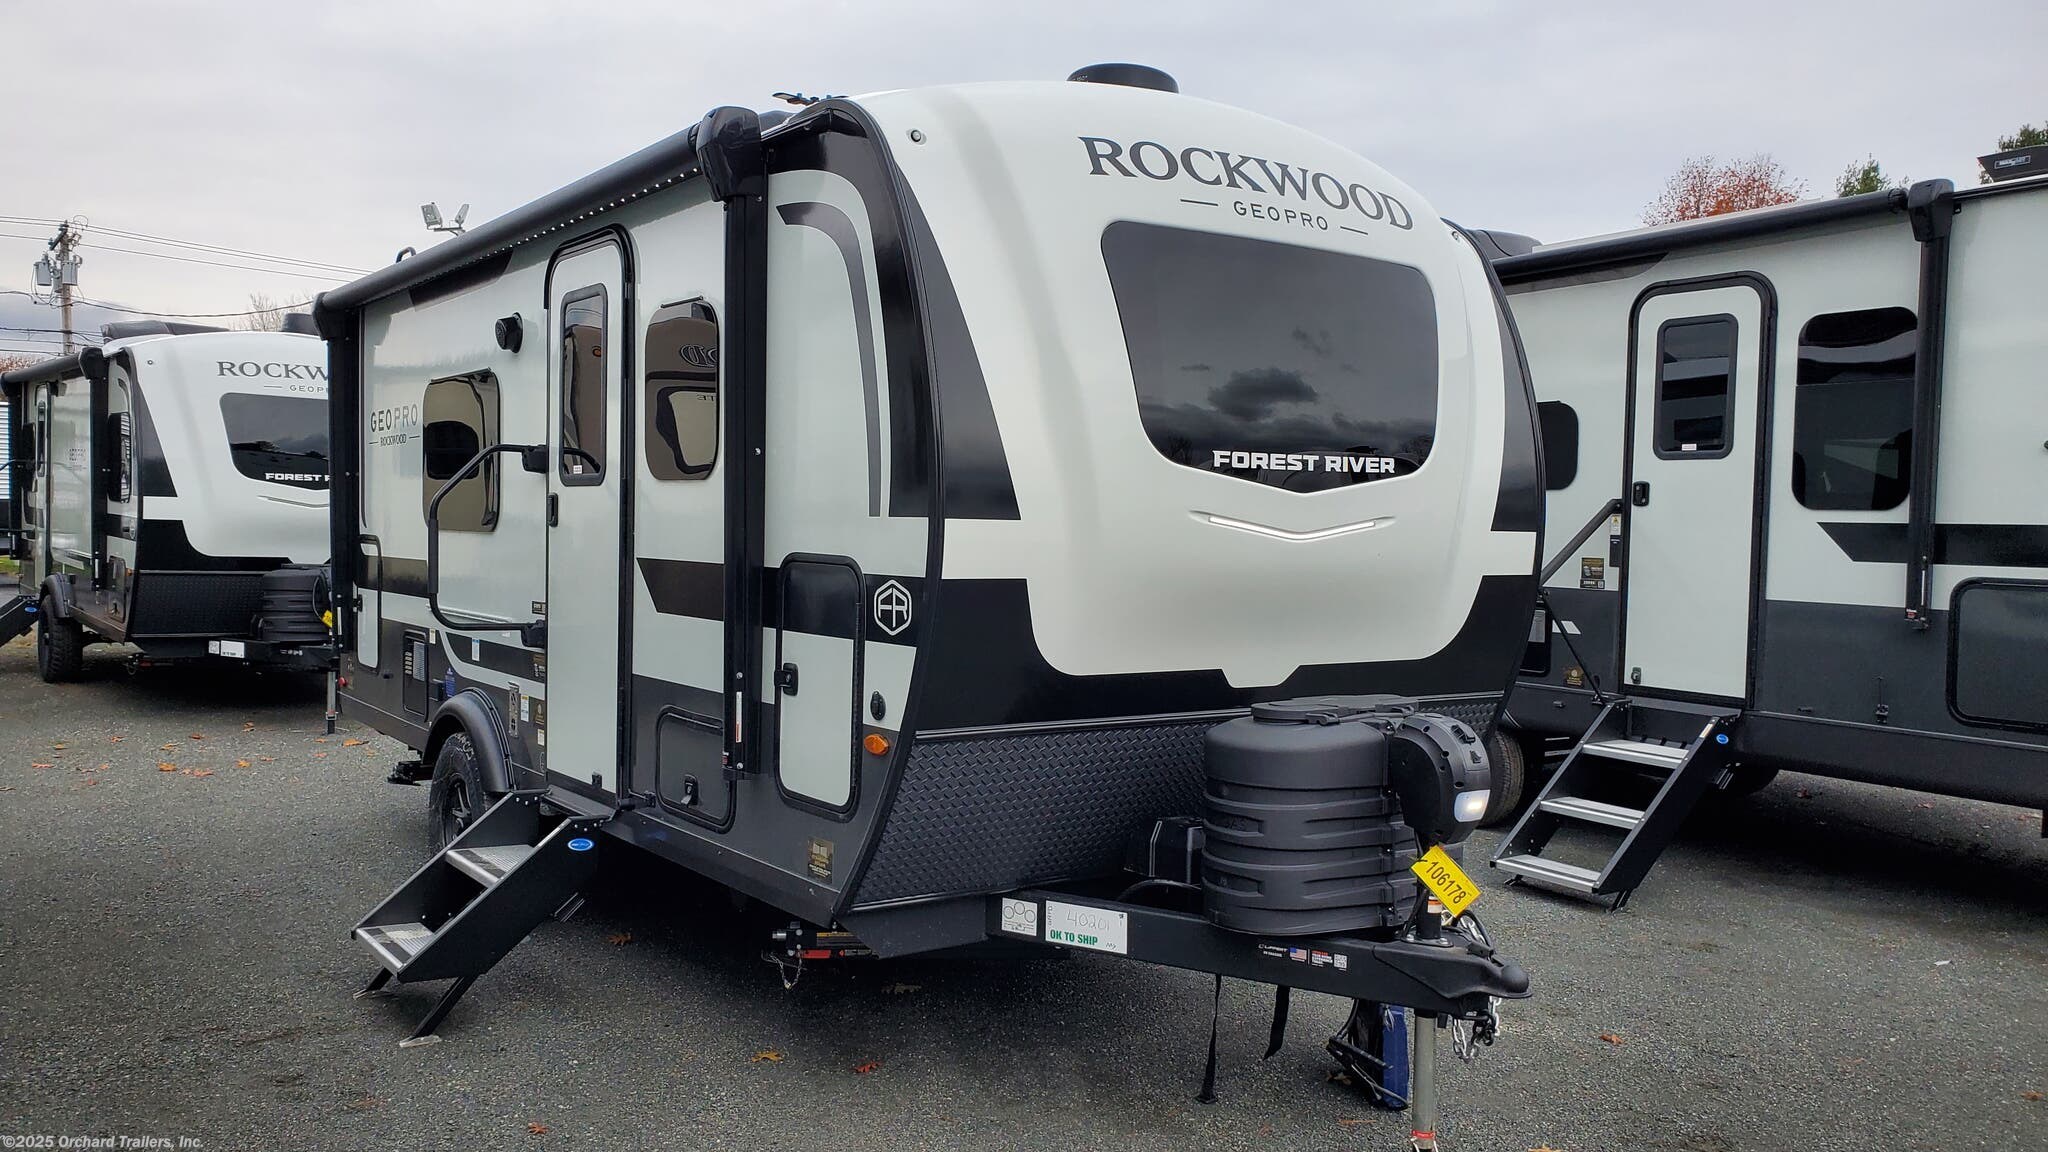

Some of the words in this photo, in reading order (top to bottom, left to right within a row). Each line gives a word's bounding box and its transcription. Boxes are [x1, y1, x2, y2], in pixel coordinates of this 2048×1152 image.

[1078, 136, 1413, 230] ROCKWOOD
[1233, 201, 1328, 231] GEOPRO
[217, 361, 328, 380] ROCKW
[290, 385, 328, 393] GEOP
[371, 404, 418, 432] GEOPRO
[380, 434, 407, 446] ROCKWOOD
[1212, 450, 1319, 471] FOREST
[1324, 455, 1395, 474] RIVER
[265, 473, 322, 481] FOREST
[1426, 861, 1467, 904] 106178
[1050, 929, 1062, 940] OK
[1064, 931, 1075, 942] TO
[1077, 934, 1098, 946] SHIP
